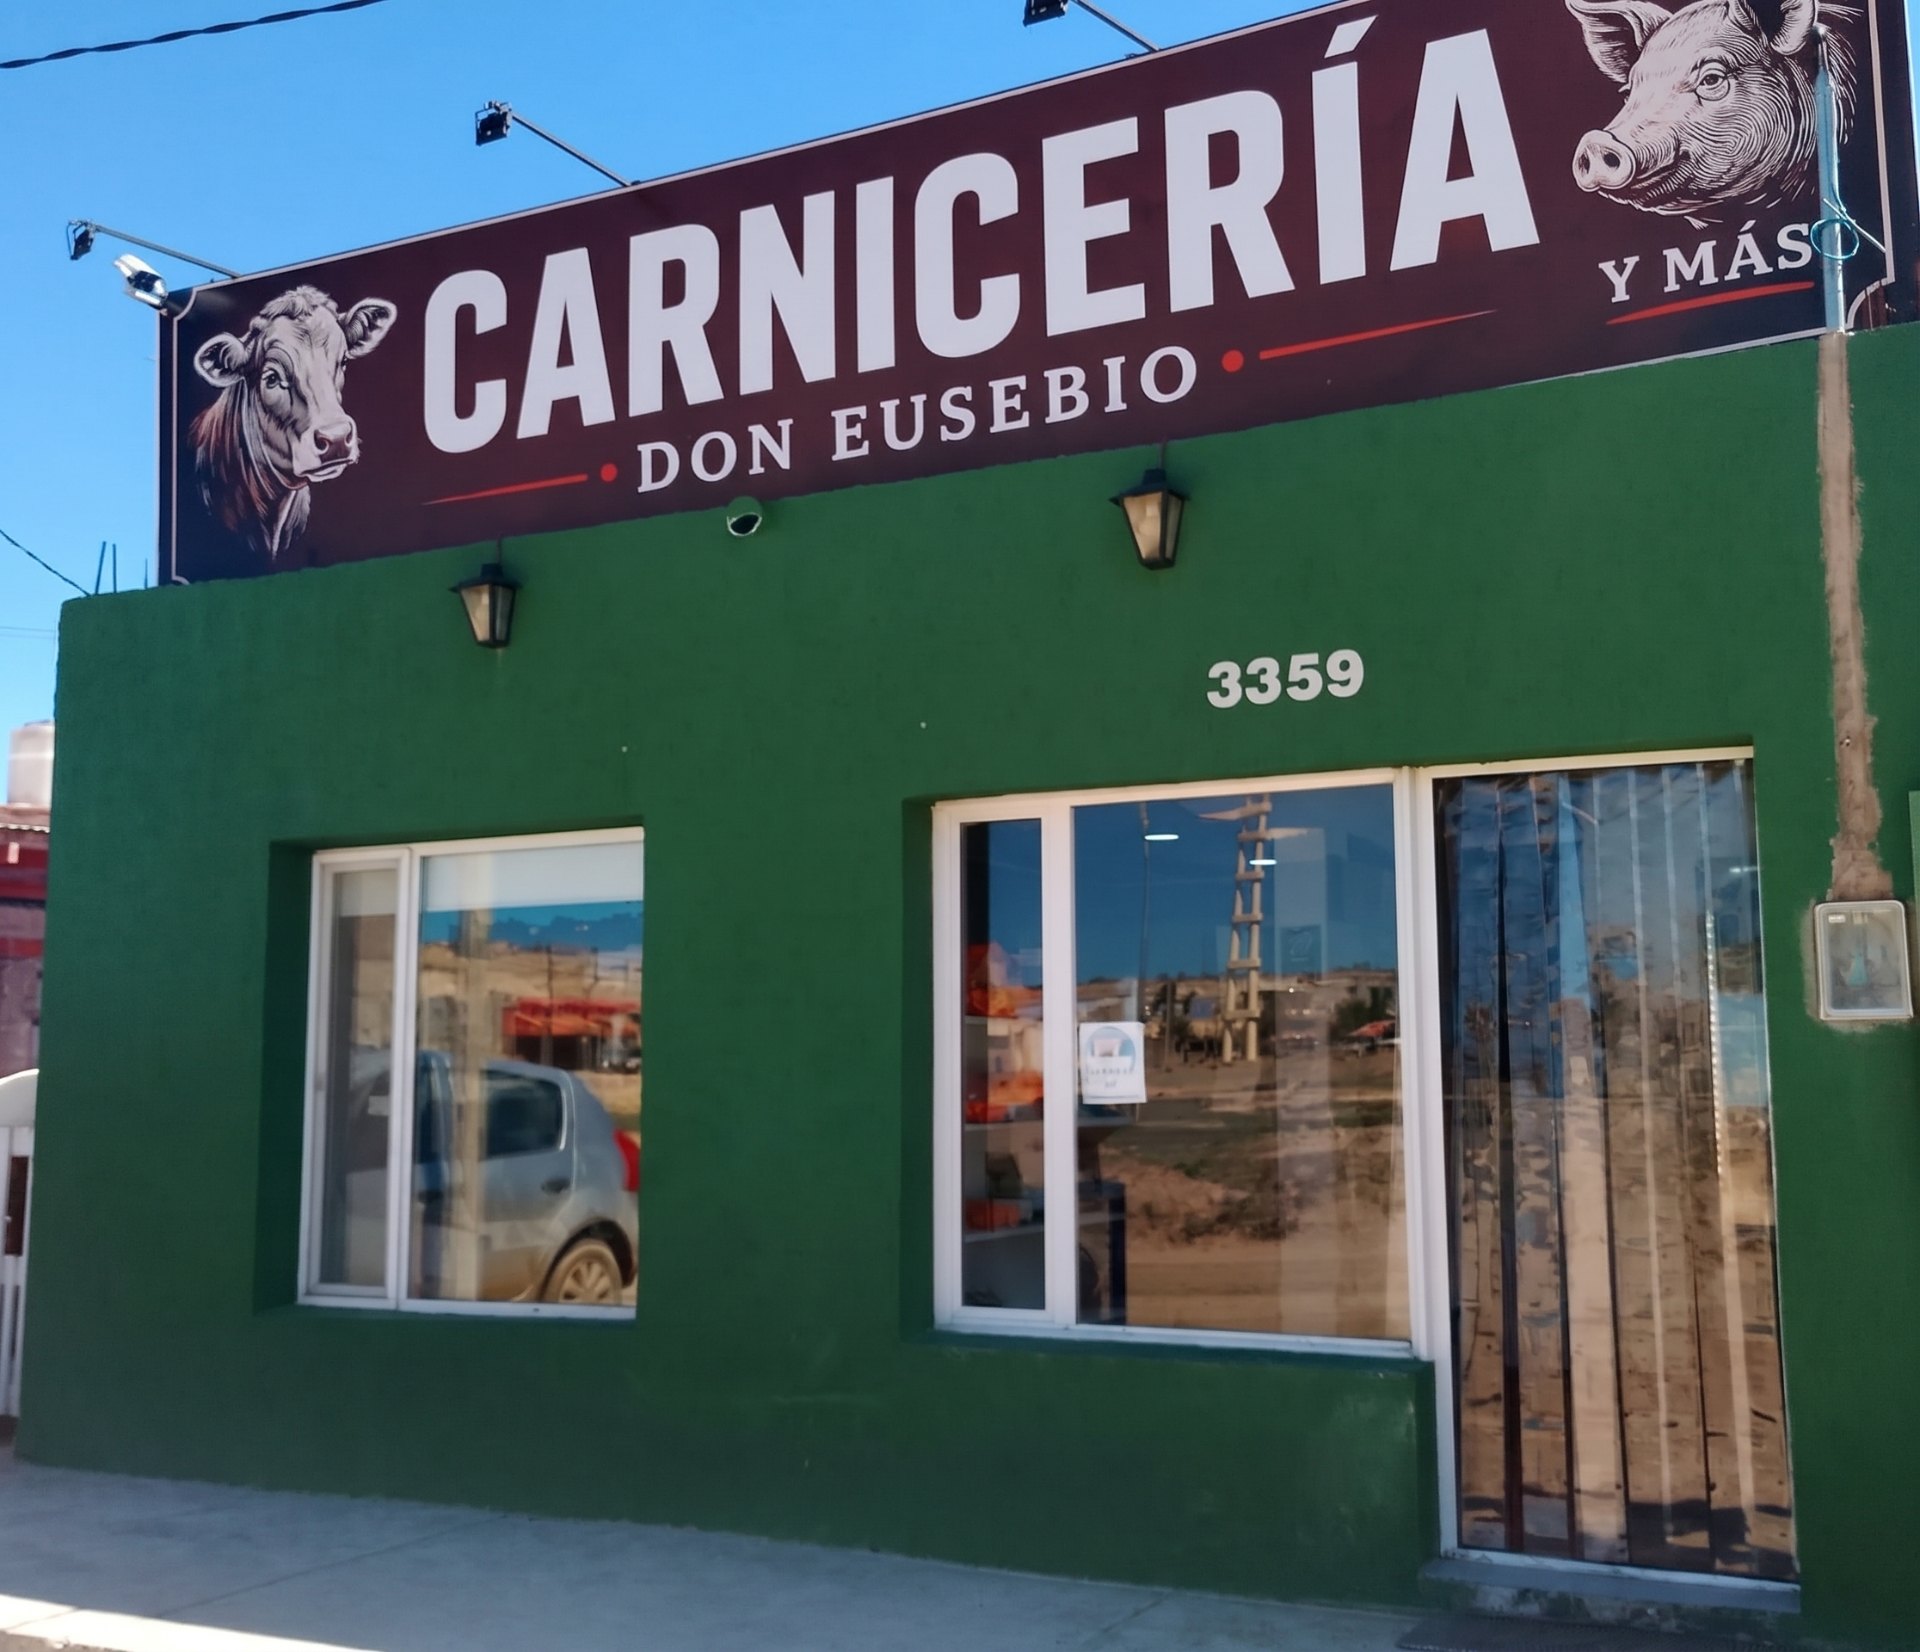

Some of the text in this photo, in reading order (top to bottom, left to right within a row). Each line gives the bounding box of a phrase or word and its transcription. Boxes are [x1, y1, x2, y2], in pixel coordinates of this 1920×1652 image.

[424, 15, 1540, 455] CARNICERÍA
[1598, 219, 1812, 303] Y MÁS
[637, 346, 1197, 493] DON EUSEBIO
[1206, 649, 1365, 709] 3359
